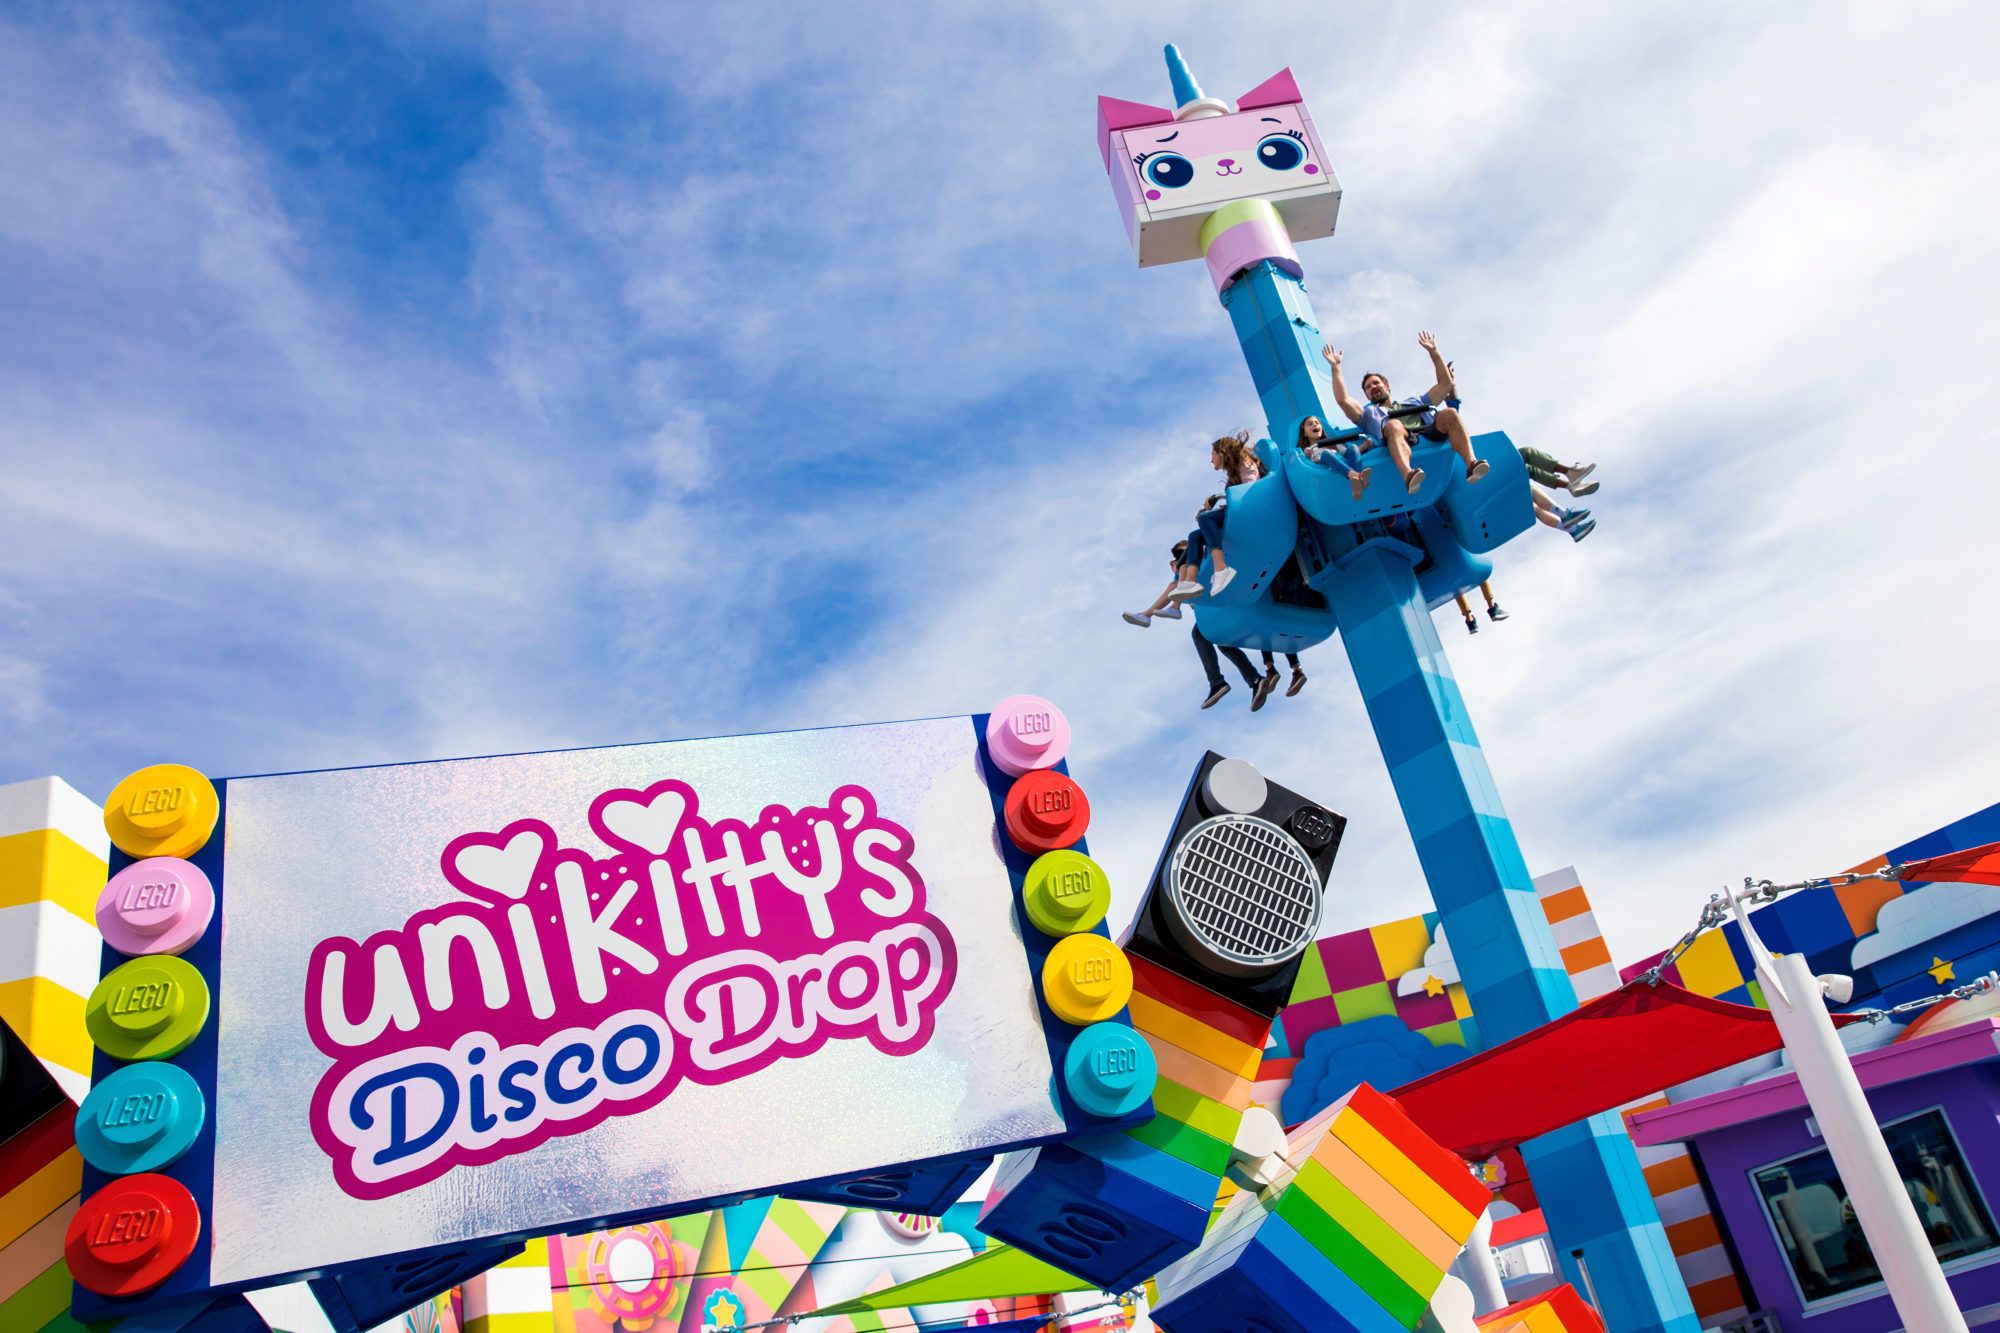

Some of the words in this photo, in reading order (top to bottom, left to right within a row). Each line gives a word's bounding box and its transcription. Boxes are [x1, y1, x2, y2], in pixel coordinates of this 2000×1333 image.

[1016, 712, 1051, 735] LEGO
[129, 786, 184, 816] LEGO
[1034, 788, 1071, 814] LEGO
[121, 881, 179, 913] LEGO
[1054, 868, 1091, 898] LEGO
[1075, 957, 1113, 984] LEGO
[112, 981, 172, 1016] LEGO
[349, 1024, 660, 1165] Disco
[684, 936, 931, 1055] Drop
[1098, 1047, 1136, 1076] LEGO
[103, 1093, 166, 1128] LEGO
[90, 1209, 159, 1248] LEGO
